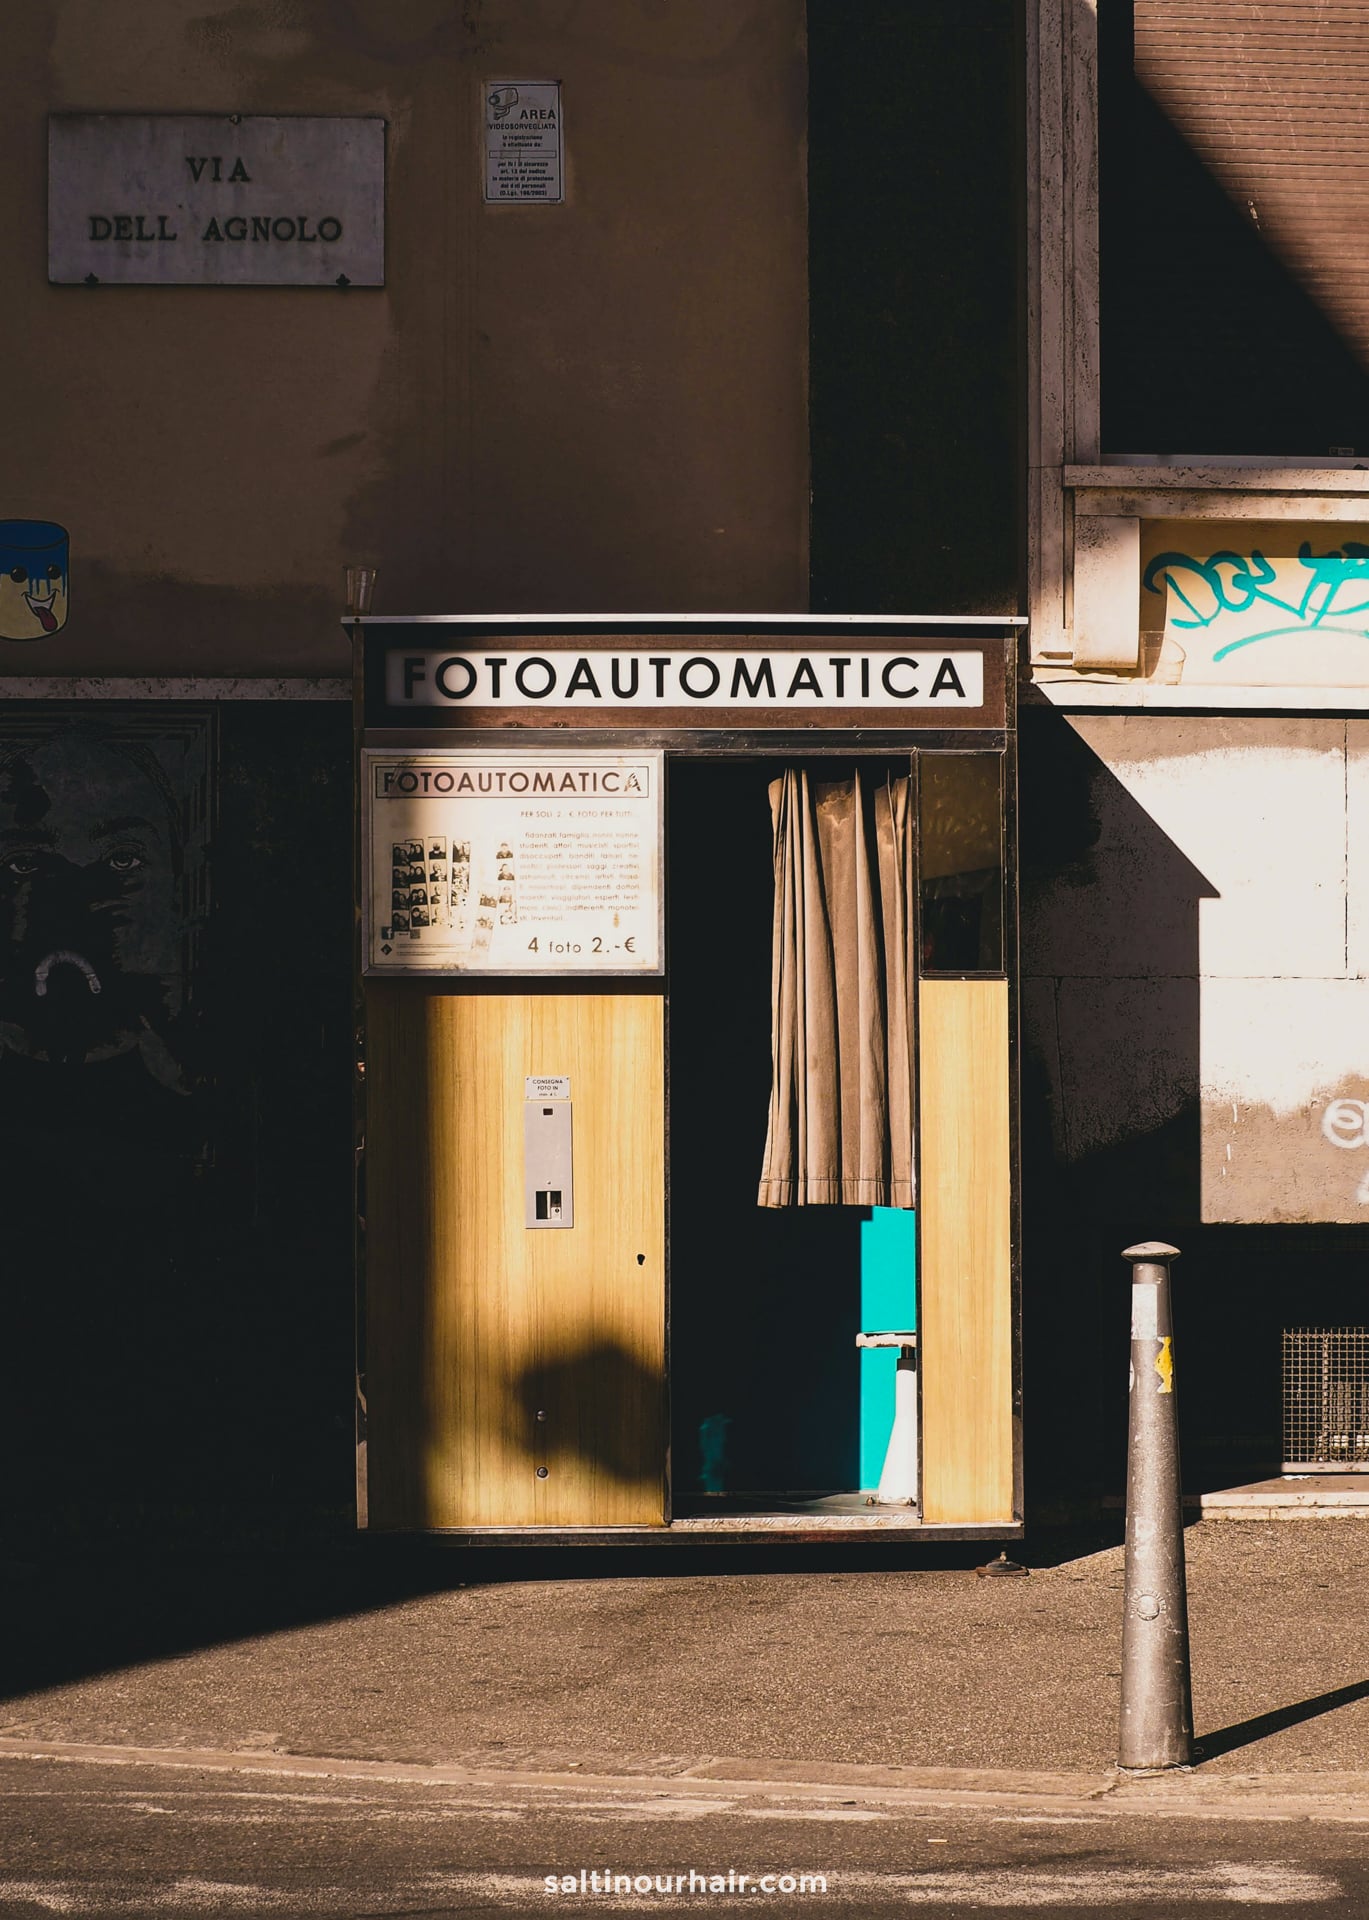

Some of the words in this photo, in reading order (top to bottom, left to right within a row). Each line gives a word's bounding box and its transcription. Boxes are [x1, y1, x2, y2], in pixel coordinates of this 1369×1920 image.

[520, 109, 556, 120] AREA
[185, 157, 252, 182] VIA
[202, 216, 344, 242] AGNOLO
[403, 656, 967, 699] FOTOAUTOMATICA
[383, 771, 642, 793] FOTOAUTOMATICA
[520, 810, 533, 818] PER
[536, 810, 553, 818] SOLI
[577, 810, 598, 818] FOTO
[600, 810, 613, 818] PER
[528, 937, 539, 953] 4
[549, 941, 582, 953] foto
